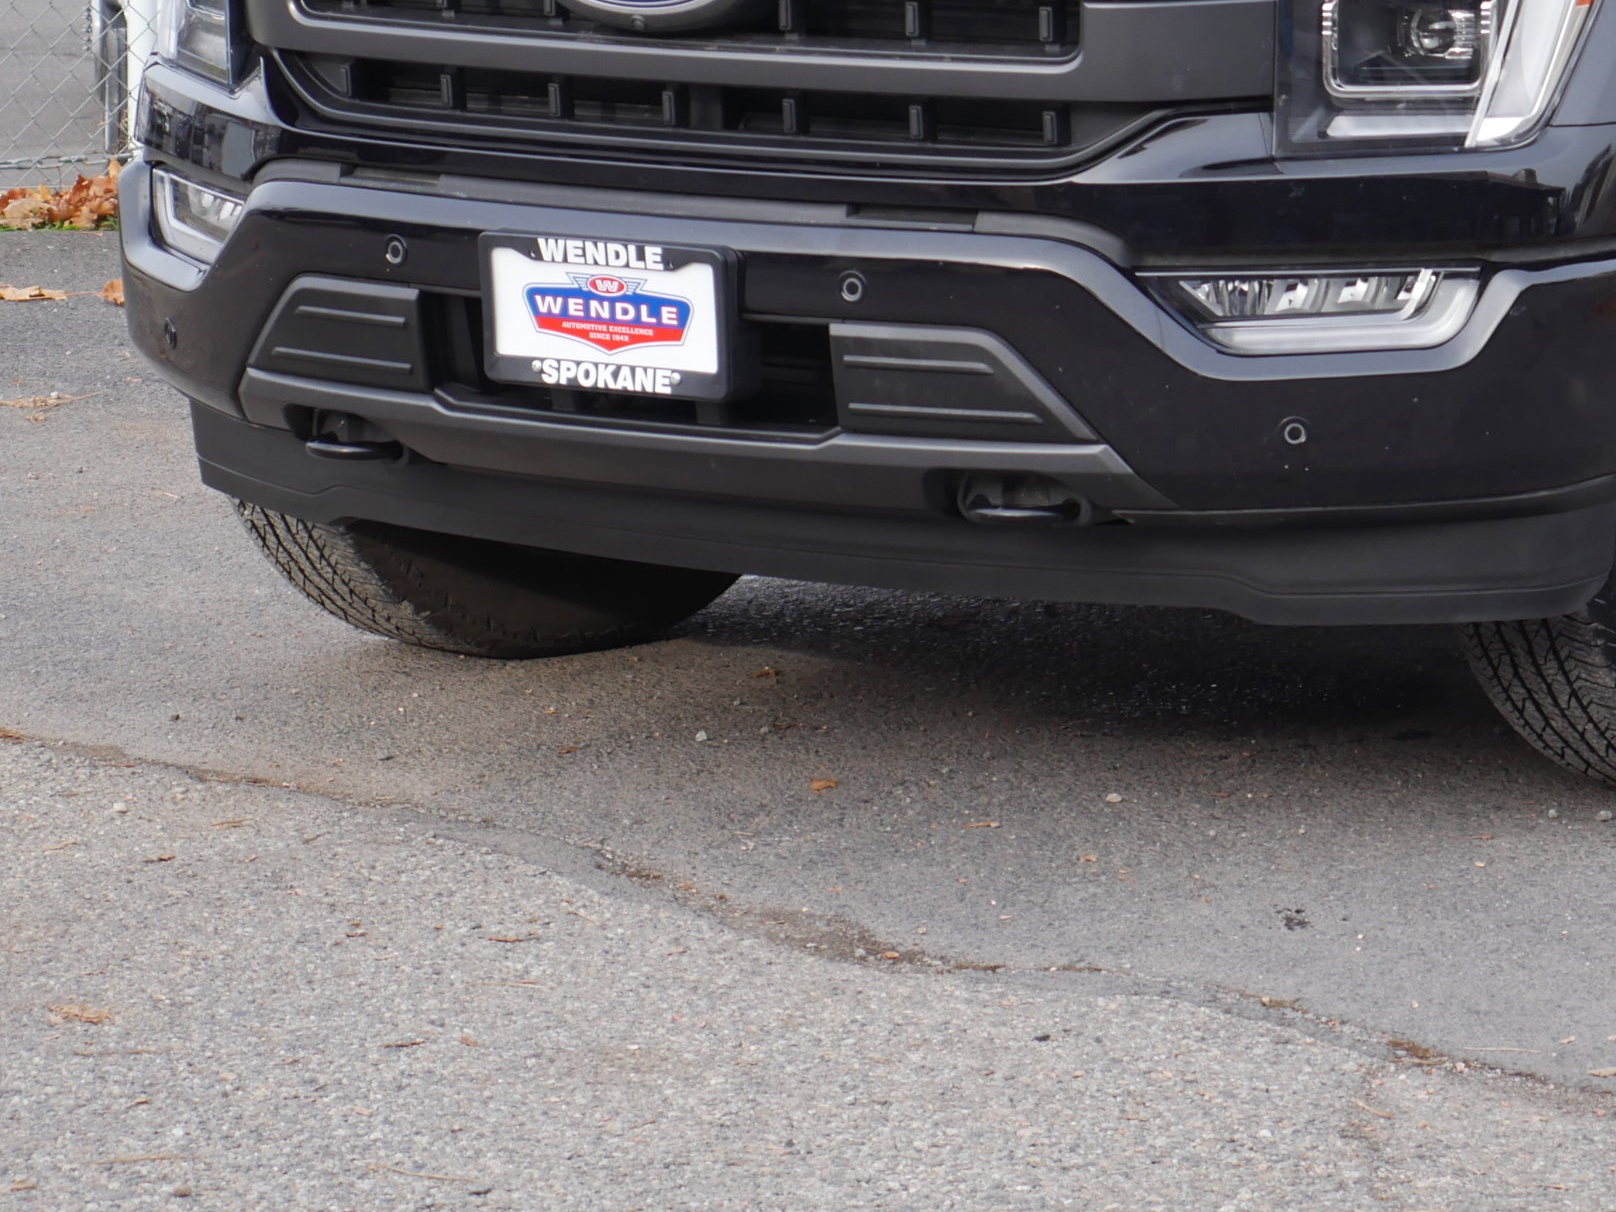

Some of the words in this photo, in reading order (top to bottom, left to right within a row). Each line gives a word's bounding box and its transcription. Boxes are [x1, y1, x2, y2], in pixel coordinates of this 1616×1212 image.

[537, 237, 665, 271] WENDLE
[594, 279, 620, 293] W
[534, 295, 679, 325] WENDLE
[562, 321, 608, 332] AUTOMOTIVE
[608, 325, 655, 337] EXCELLENCE
[589, 332, 611, 341] SINCE
[541, 359, 673, 394] SPOKANE
